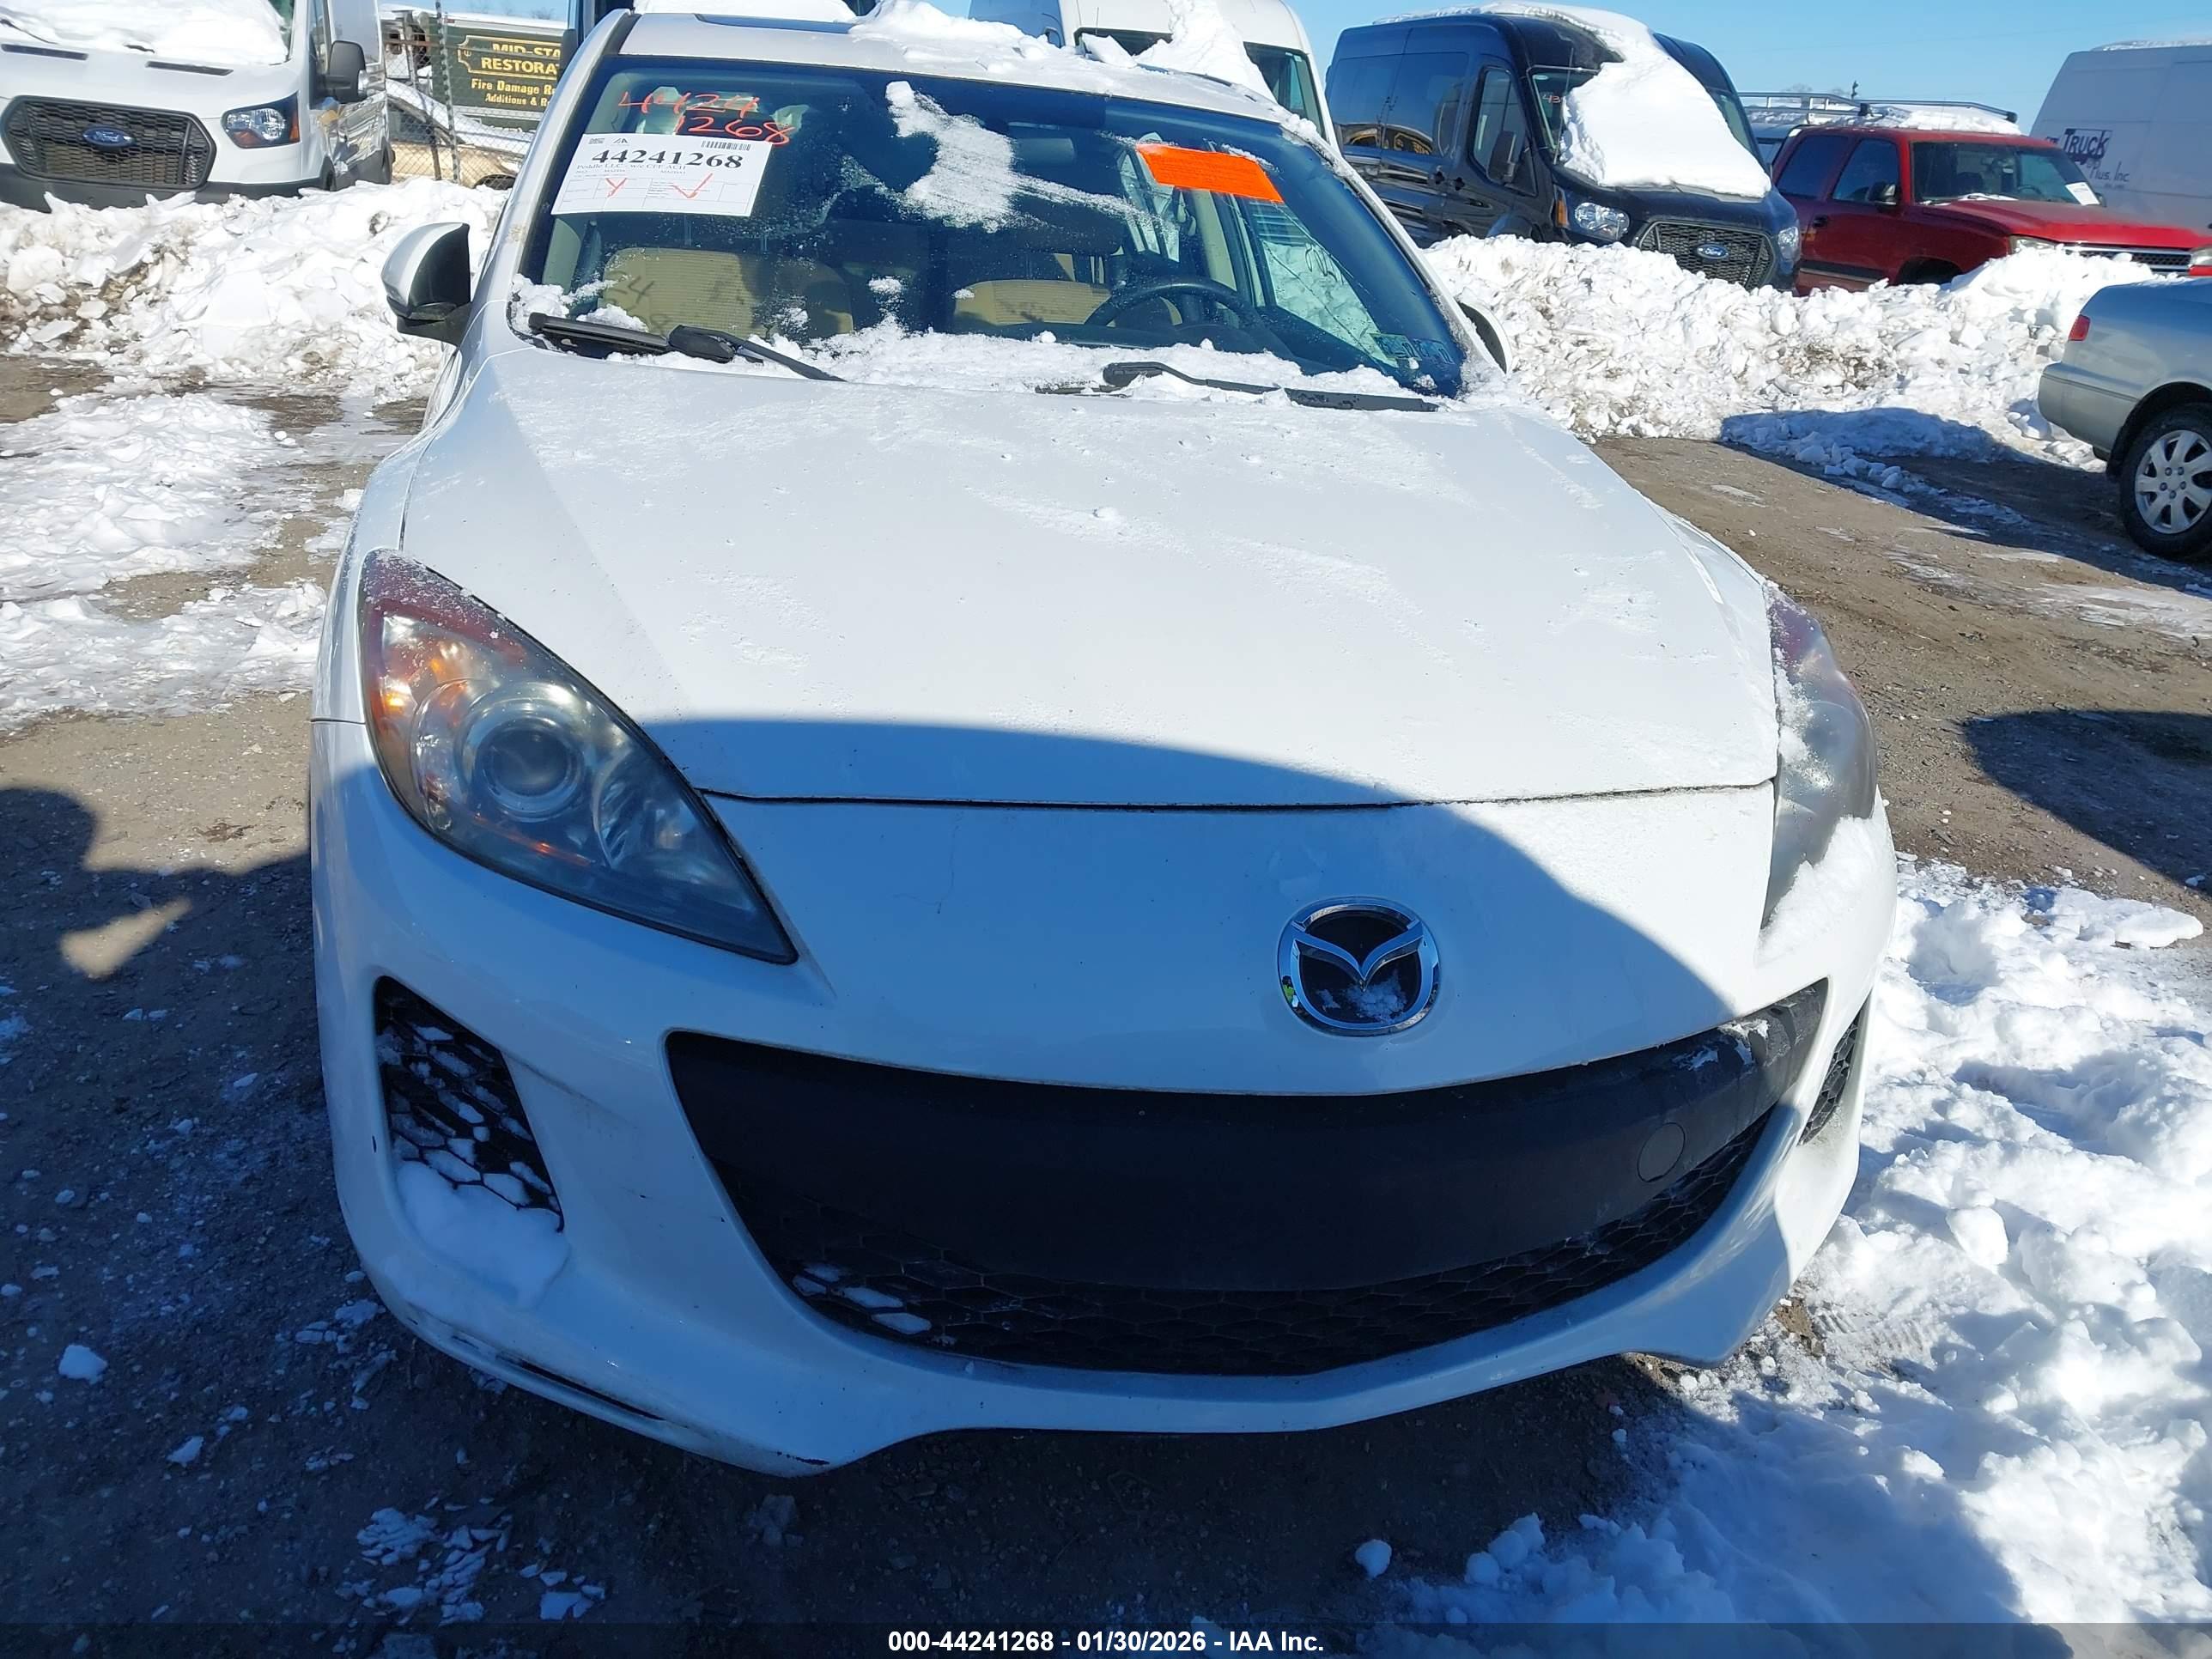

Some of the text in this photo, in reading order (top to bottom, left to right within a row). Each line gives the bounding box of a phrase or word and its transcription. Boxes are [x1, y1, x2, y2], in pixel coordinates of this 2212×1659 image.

[481, 57, 561, 76] RESTORA
[471, 78, 493, 90] Fire
[496, 80, 539, 95] Damage
[485, 93, 526, 106] Additions
[530, 97, 538, 106] &
[618, 91, 760, 118] 4424
[672, 115, 796, 145] 1268
[591, 149, 744, 169] 44241268
